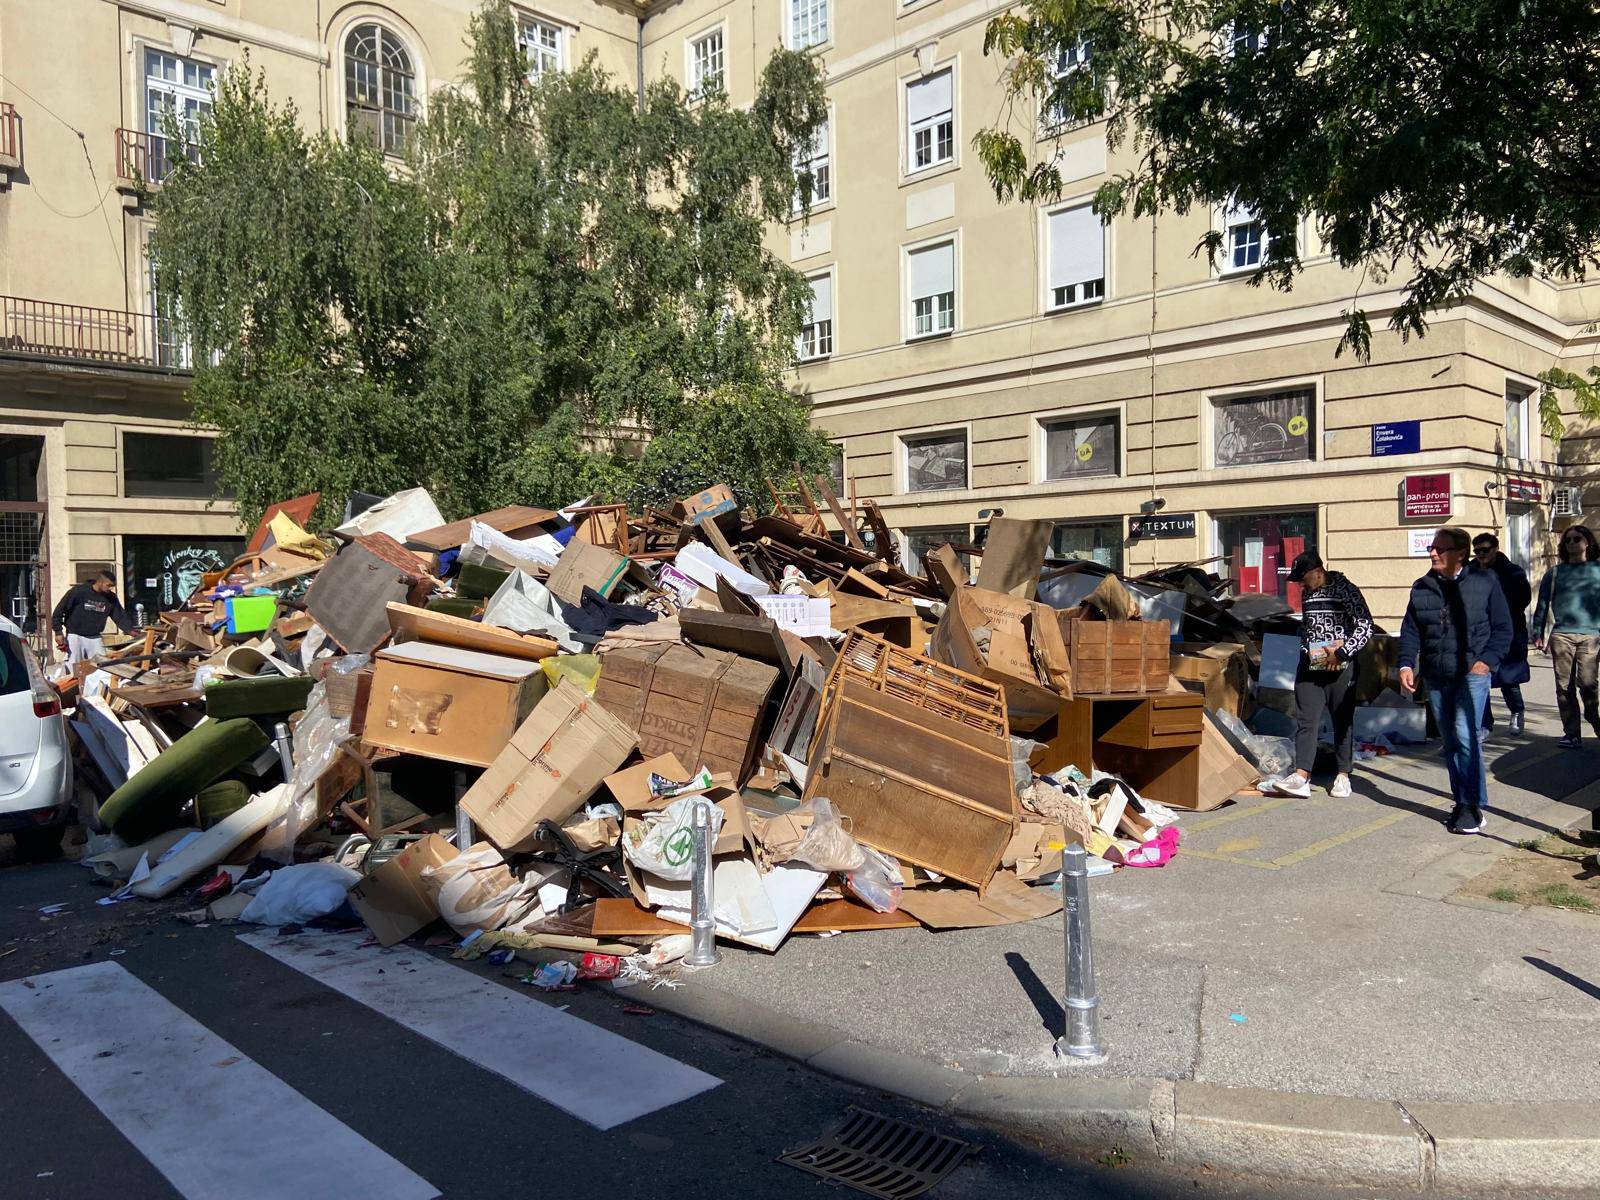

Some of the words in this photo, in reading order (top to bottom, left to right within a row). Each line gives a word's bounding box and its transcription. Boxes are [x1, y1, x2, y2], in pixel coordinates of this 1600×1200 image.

[1145, 520, 1195, 531] TEXTUM
[163, 545, 204, 569] Monkey
[783, 688, 802, 733] JVC
[642, 712, 698, 740] STAKLO
